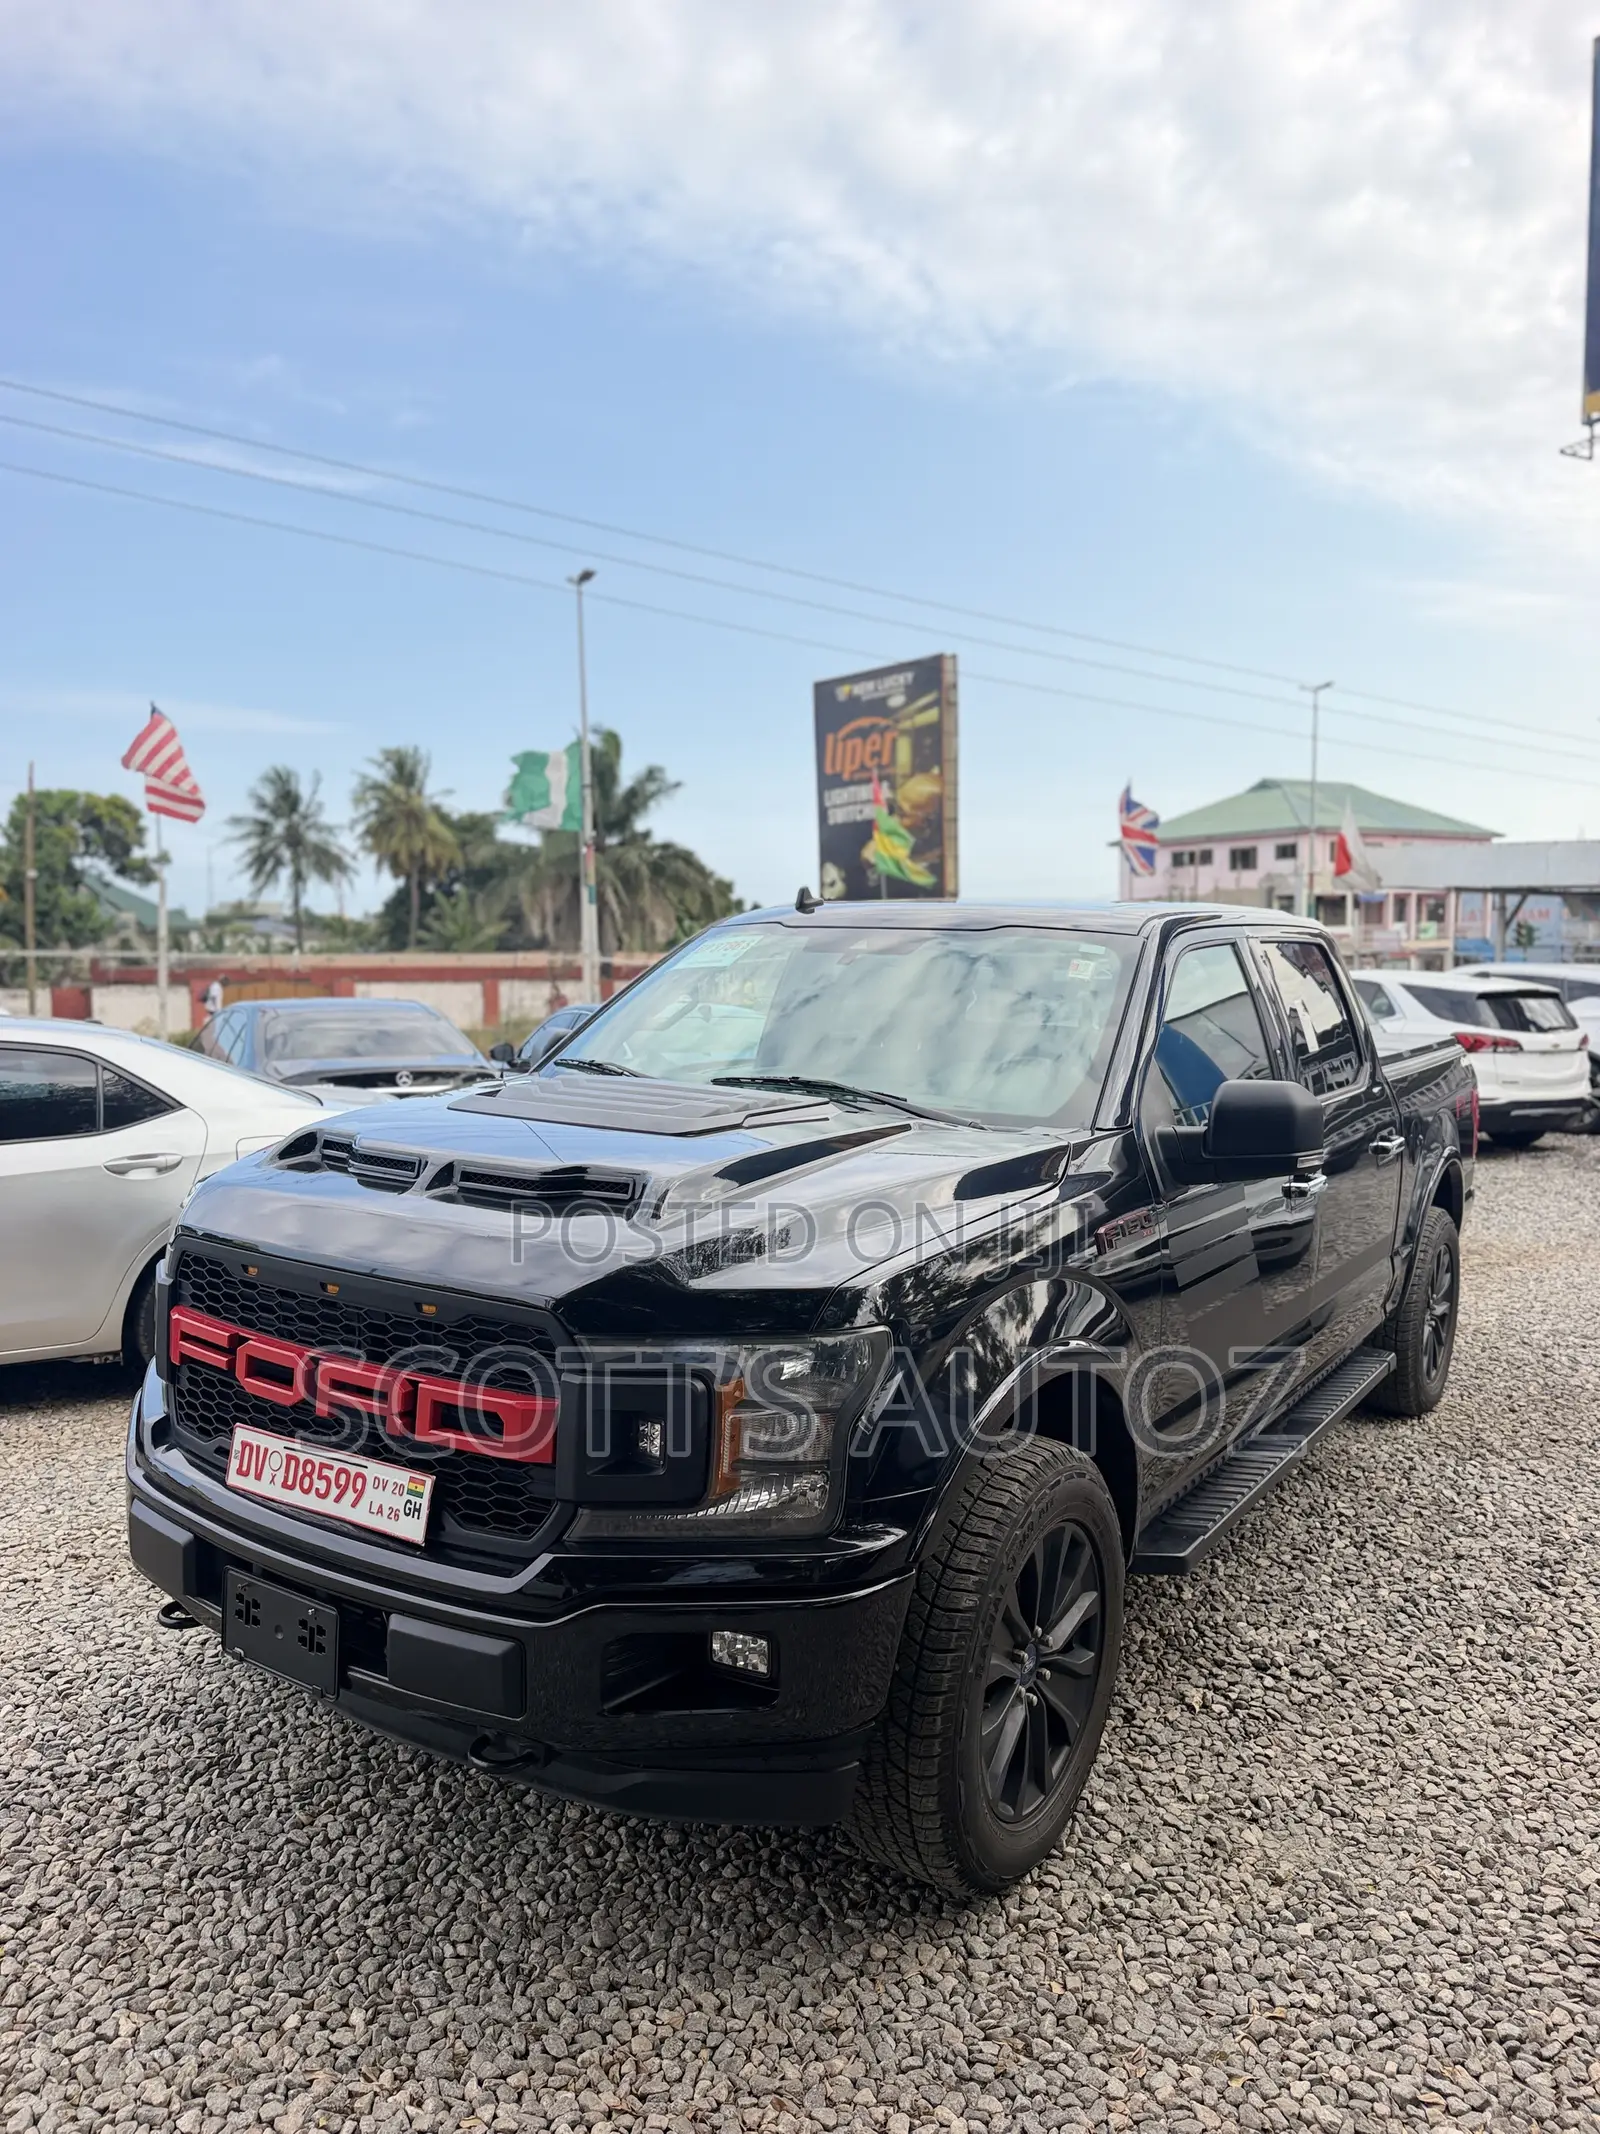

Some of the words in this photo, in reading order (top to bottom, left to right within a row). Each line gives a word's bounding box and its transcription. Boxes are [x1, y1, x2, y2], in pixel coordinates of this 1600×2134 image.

[877, 671, 915, 691] LUCKY
[828, 804, 876, 826] SWITCH
[170, 1305, 560, 1464] FORD
[236, 1440, 269, 1482] DV
[281, 1453, 368, 1509] D8599
[372, 1477, 388, 1492] DV
[392, 1482, 405, 1496] 20
[369, 1501, 384, 1517] LA
[387, 1507, 400, 1522] 26
[403, 1499, 422, 1520] GH
